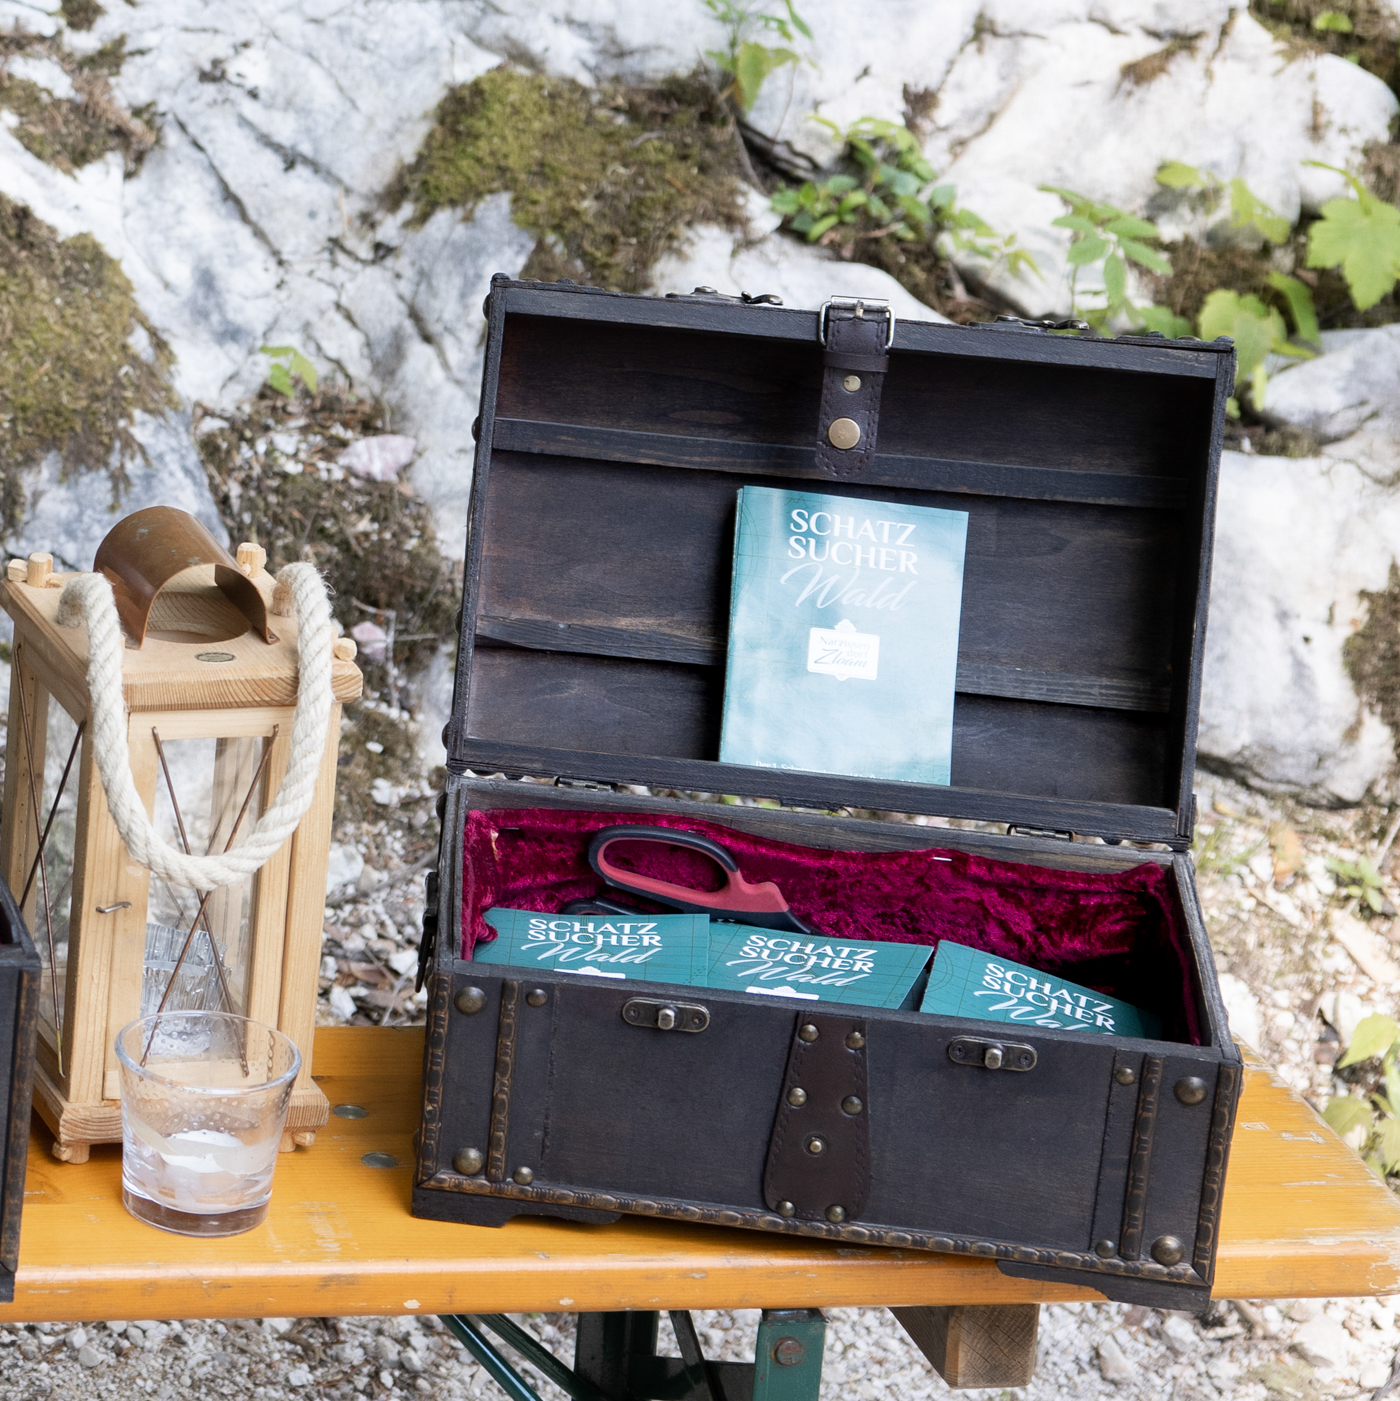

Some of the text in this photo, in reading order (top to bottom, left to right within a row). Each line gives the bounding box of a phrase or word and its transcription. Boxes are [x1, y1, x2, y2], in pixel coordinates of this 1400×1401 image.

[790, 508, 917, 547] SCHATZ
[788, 535, 919, 575] SUCHER
[780, 562, 918, 611] Wald
[528, 918, 658, 935] SCHATZ
[528, 930, 663, 947] SUCHER
[520, 941, 663, 964] Wald
[739, 946, 875, 973] SUCHER
[746, 935, 878, 962] SCHATZ
[726, 959, 870, 987] Wald
[982, 975, 1116, 1032] SUCHER
[985, 963, 1115, 1017] SCHATZ
